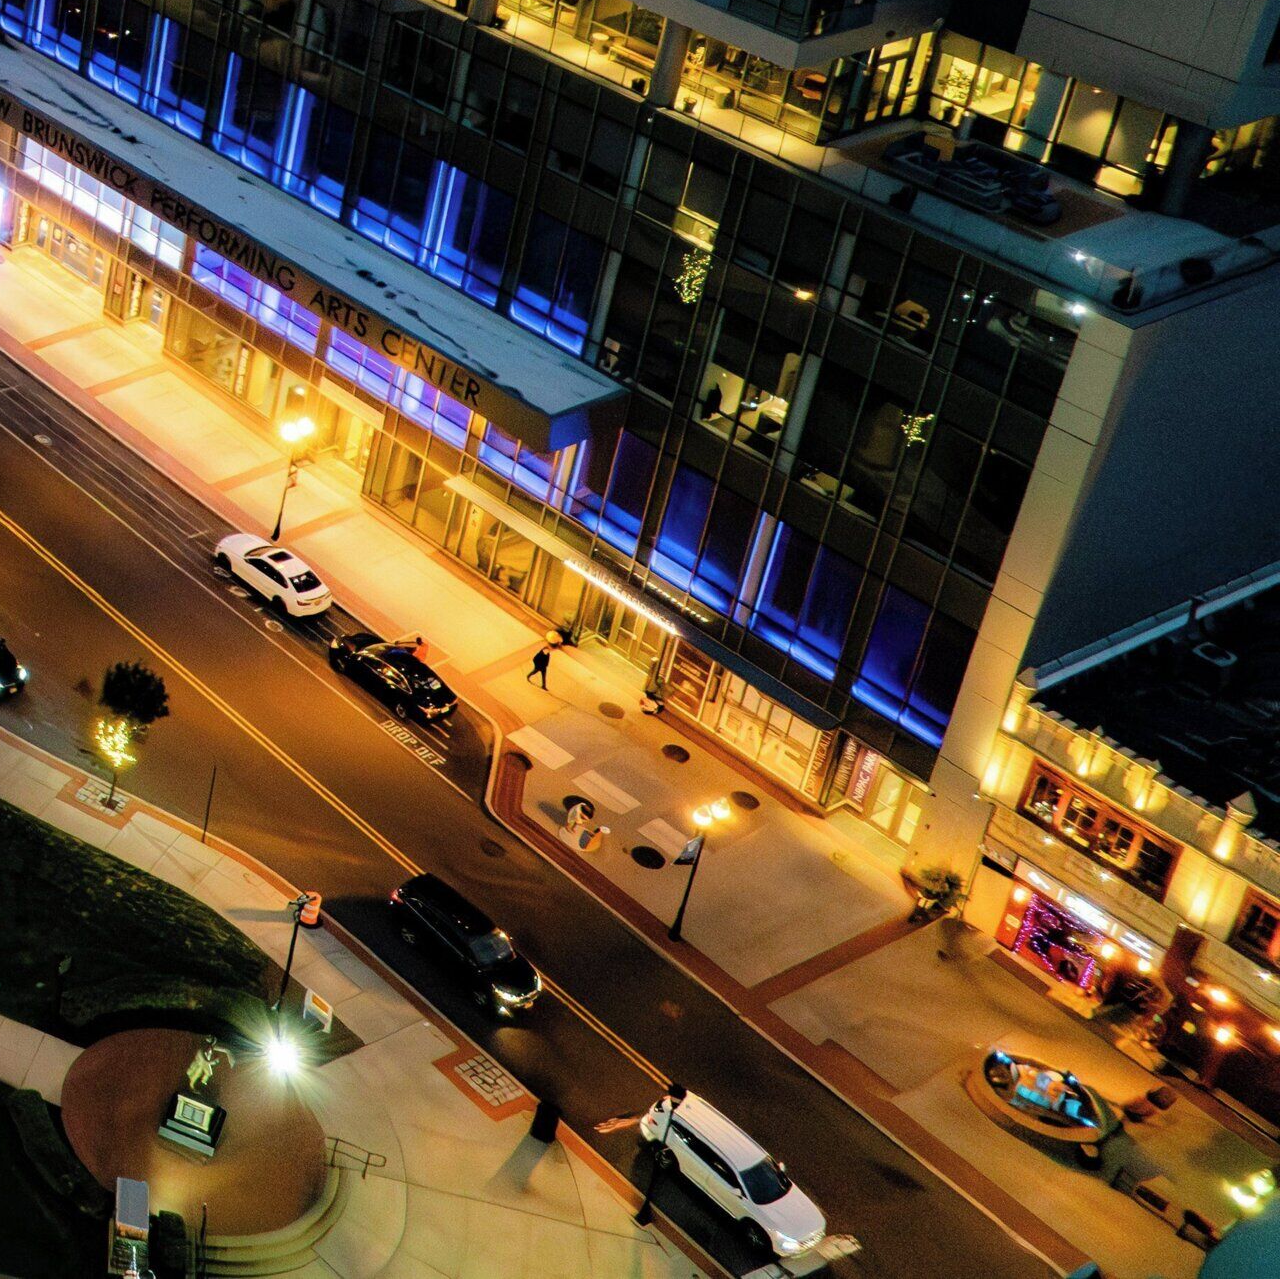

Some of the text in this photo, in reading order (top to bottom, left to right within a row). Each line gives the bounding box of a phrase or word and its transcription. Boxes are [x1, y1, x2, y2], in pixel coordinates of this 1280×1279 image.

[23, 111, 140, 197] BRUNSWICK
[150, 188, 295, 292] PERFORMING
[309, 290, 369, 337] ARTS
[380, 329, 481, 407] CENTER
[380, 719, 445, 765] DROP-OFF
[861, 750, 878, 774] PARK
